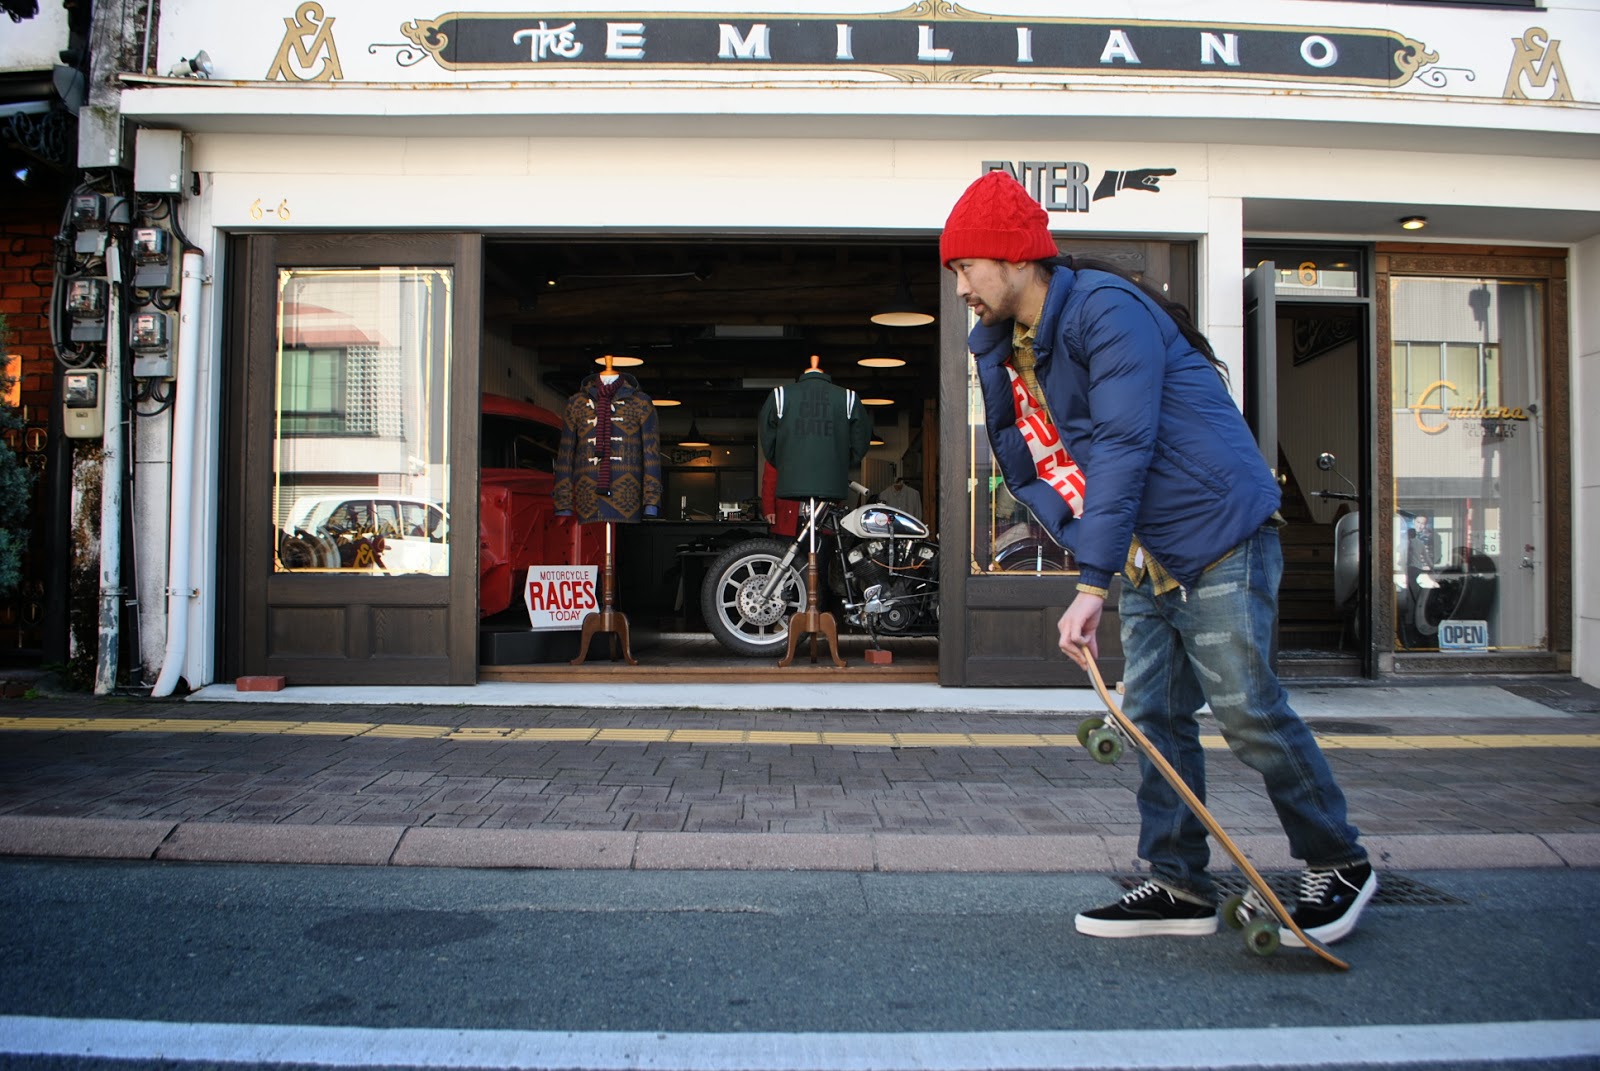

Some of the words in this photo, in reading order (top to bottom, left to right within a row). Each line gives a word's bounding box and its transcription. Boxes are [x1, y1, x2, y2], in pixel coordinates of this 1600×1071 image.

[606, 22, 1339, 69] EMILIANO
[251, 198, 290, 221] 6-6
[540, 571, 589, 581] MOTORCYCLE
[529, 581, 596, 611] RACES
[549, 610, 581, 621] TODAY
[1443, 625, 1484, 644] OPEN
